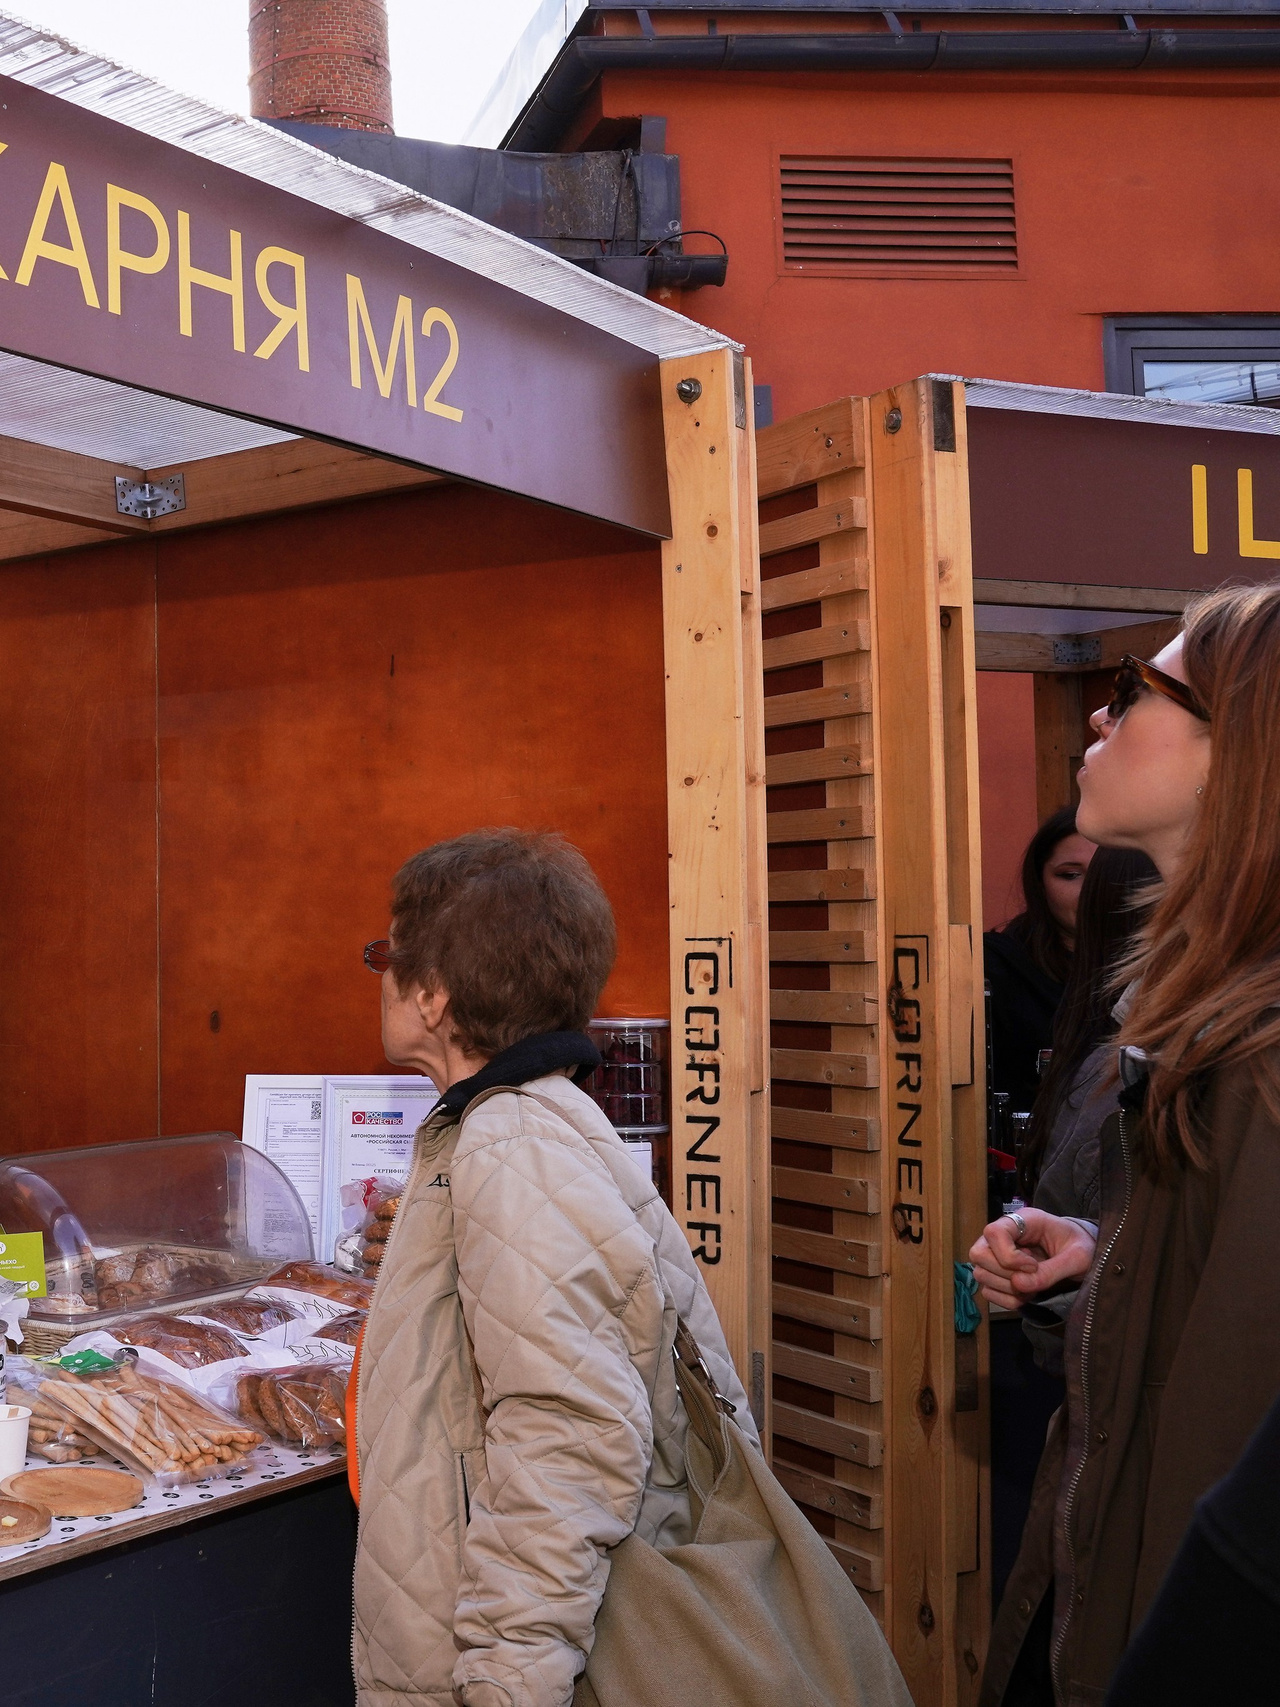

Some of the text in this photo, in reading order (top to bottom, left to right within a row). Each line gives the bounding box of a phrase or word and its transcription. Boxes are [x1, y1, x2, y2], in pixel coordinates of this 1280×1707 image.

[346, 273, 464, 423] М2
[685, 952, 721, 1265] CORNER
[893, 947, 923, 1245] CORNER
